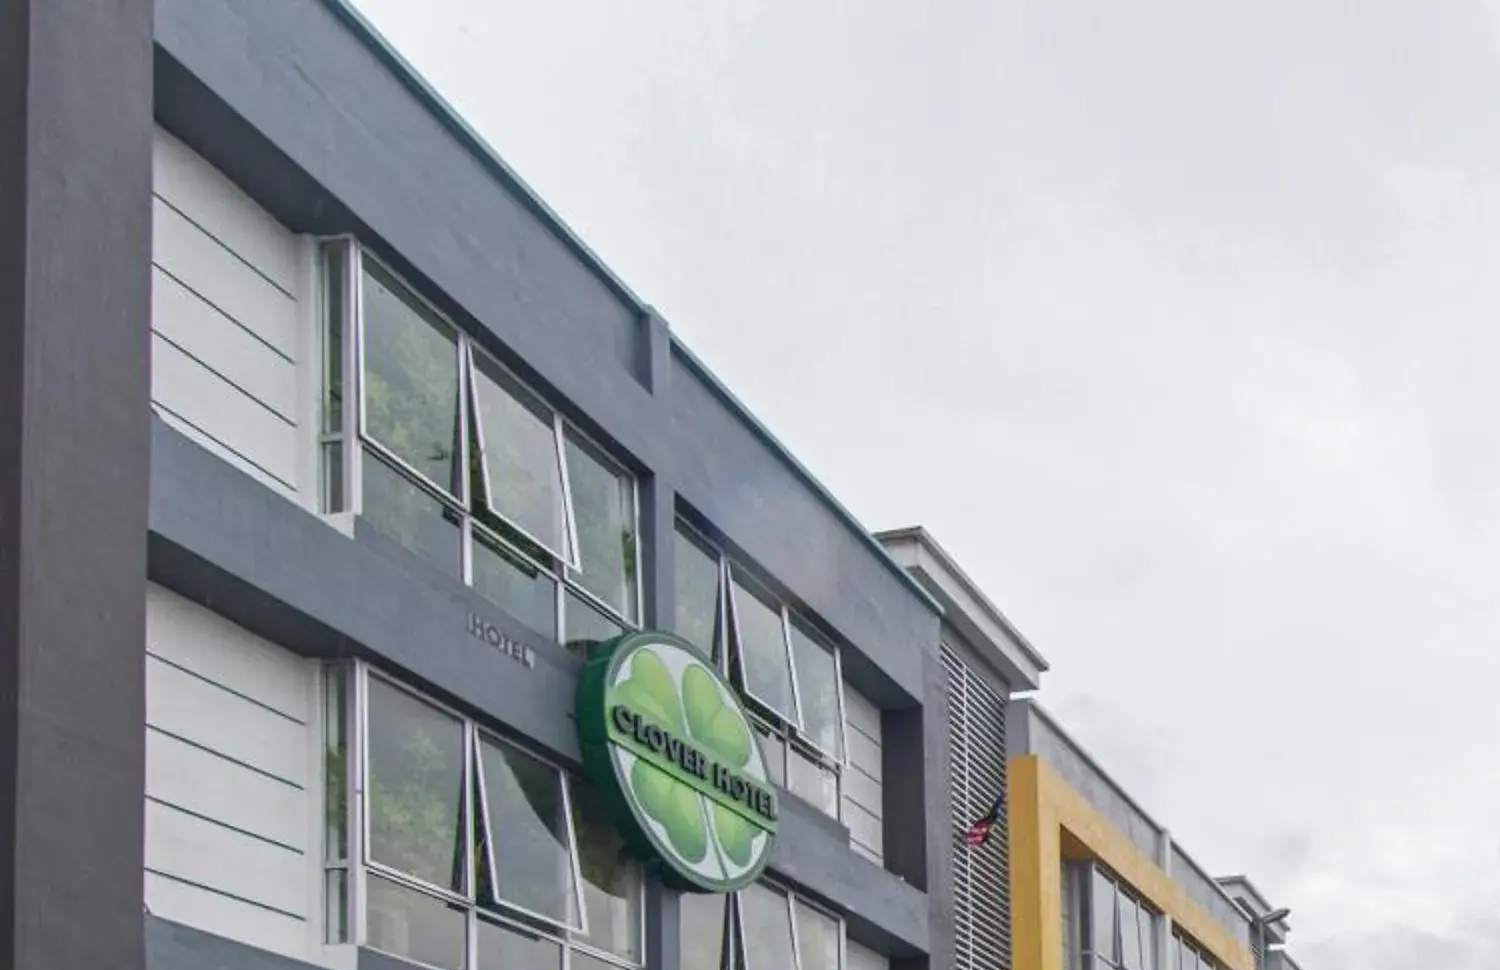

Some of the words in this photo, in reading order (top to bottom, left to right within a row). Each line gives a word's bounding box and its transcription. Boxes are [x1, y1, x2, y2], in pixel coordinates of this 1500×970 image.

[465, 610, 536, 671] HOTEL
[612, 704, 708, 781] CLOVER
[713, 762, 779, 822] HOTEL
